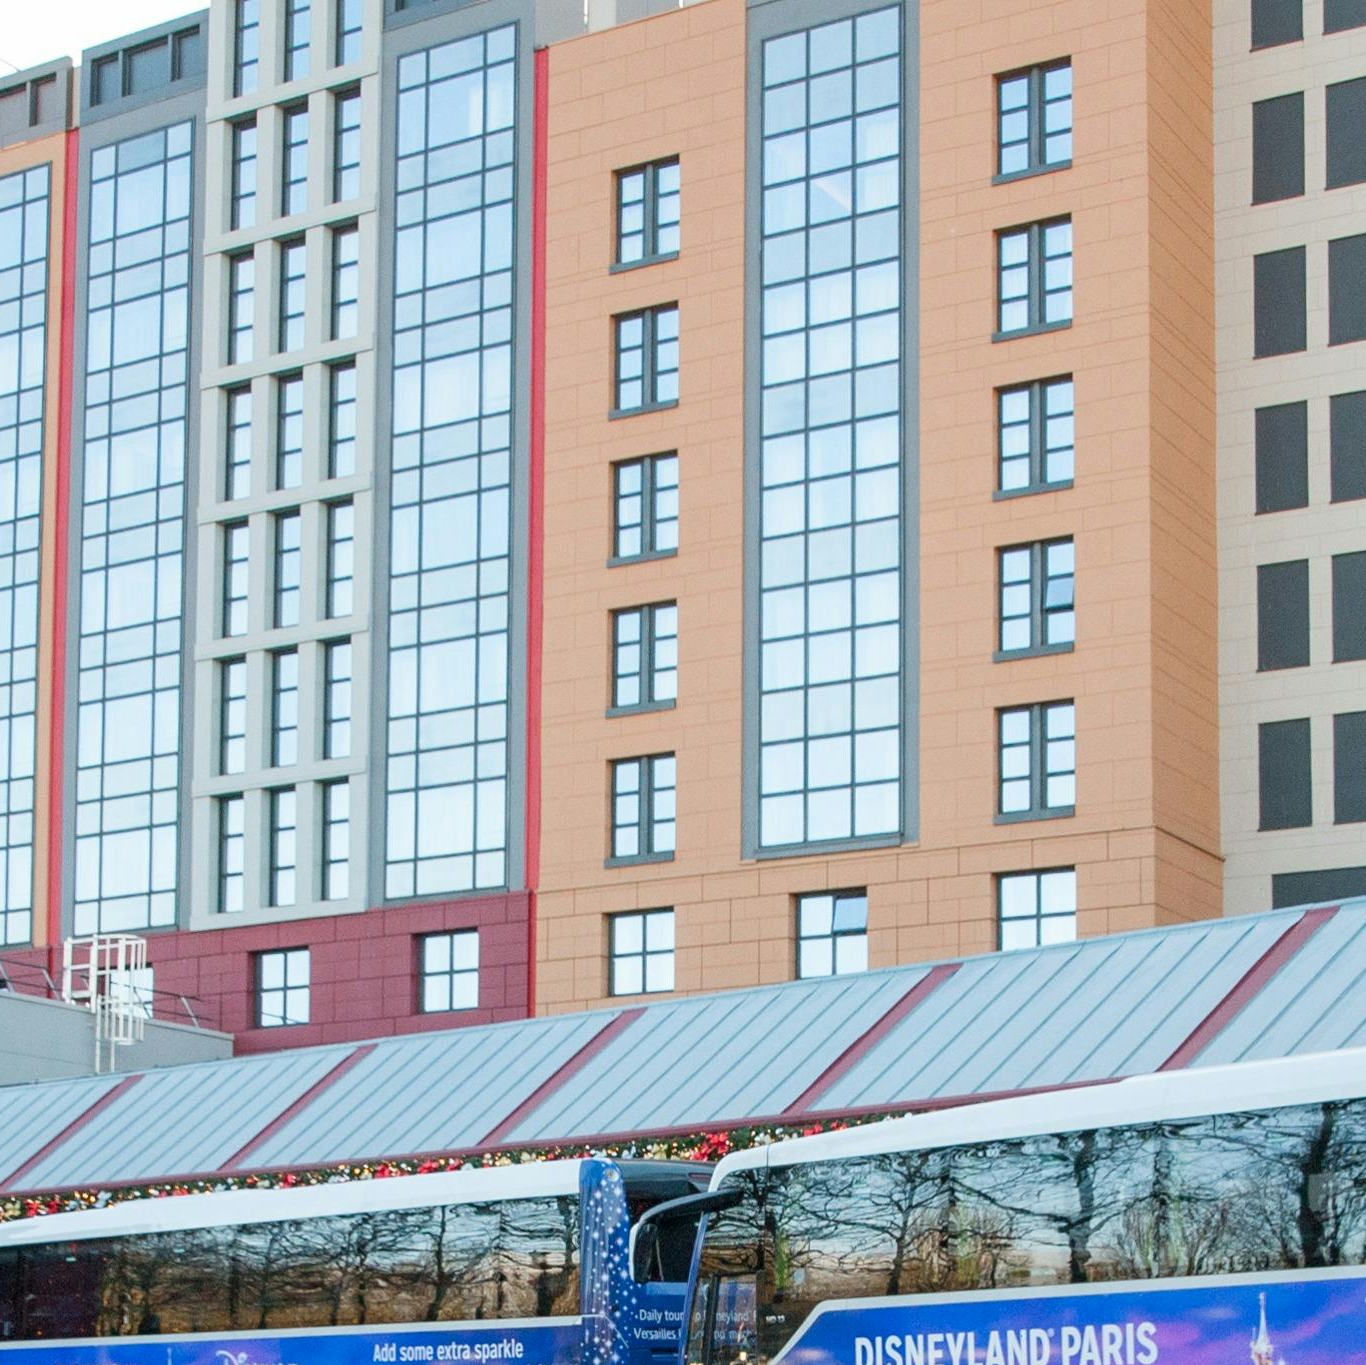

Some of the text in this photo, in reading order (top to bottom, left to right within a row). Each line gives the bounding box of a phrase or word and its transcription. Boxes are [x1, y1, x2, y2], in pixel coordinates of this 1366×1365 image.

[639, 1309, 662, 1323] Daily
[664, 1310, 684, 1322] tour
[633, 1327, 677, 1341] Versailles
[373, 1338, 523, 1363] Add some extra sparkle
